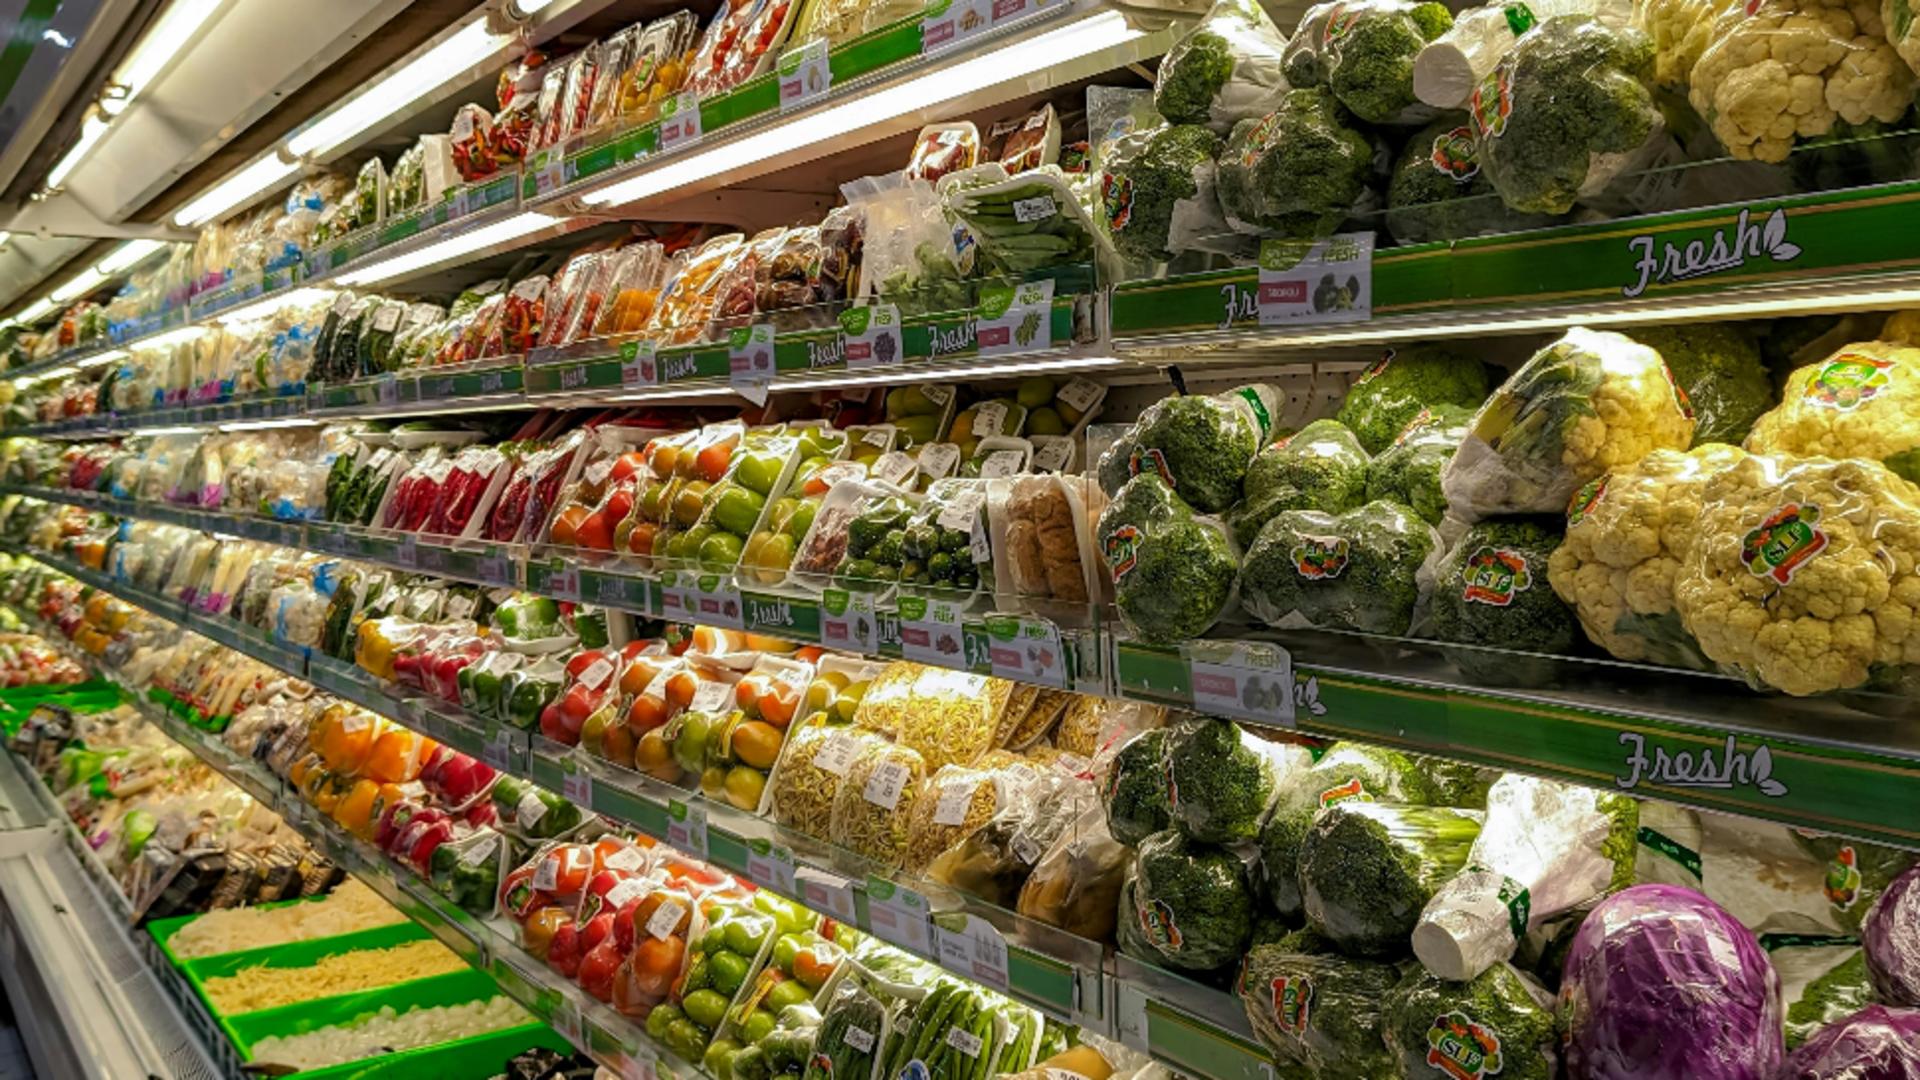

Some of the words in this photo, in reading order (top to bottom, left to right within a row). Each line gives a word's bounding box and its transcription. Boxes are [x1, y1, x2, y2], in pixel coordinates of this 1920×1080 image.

[1624, 208, 1760, 297] Fresh
[926, 312, 976, 364] Fresh
[1616, 733, 1750, 789] Fresh
